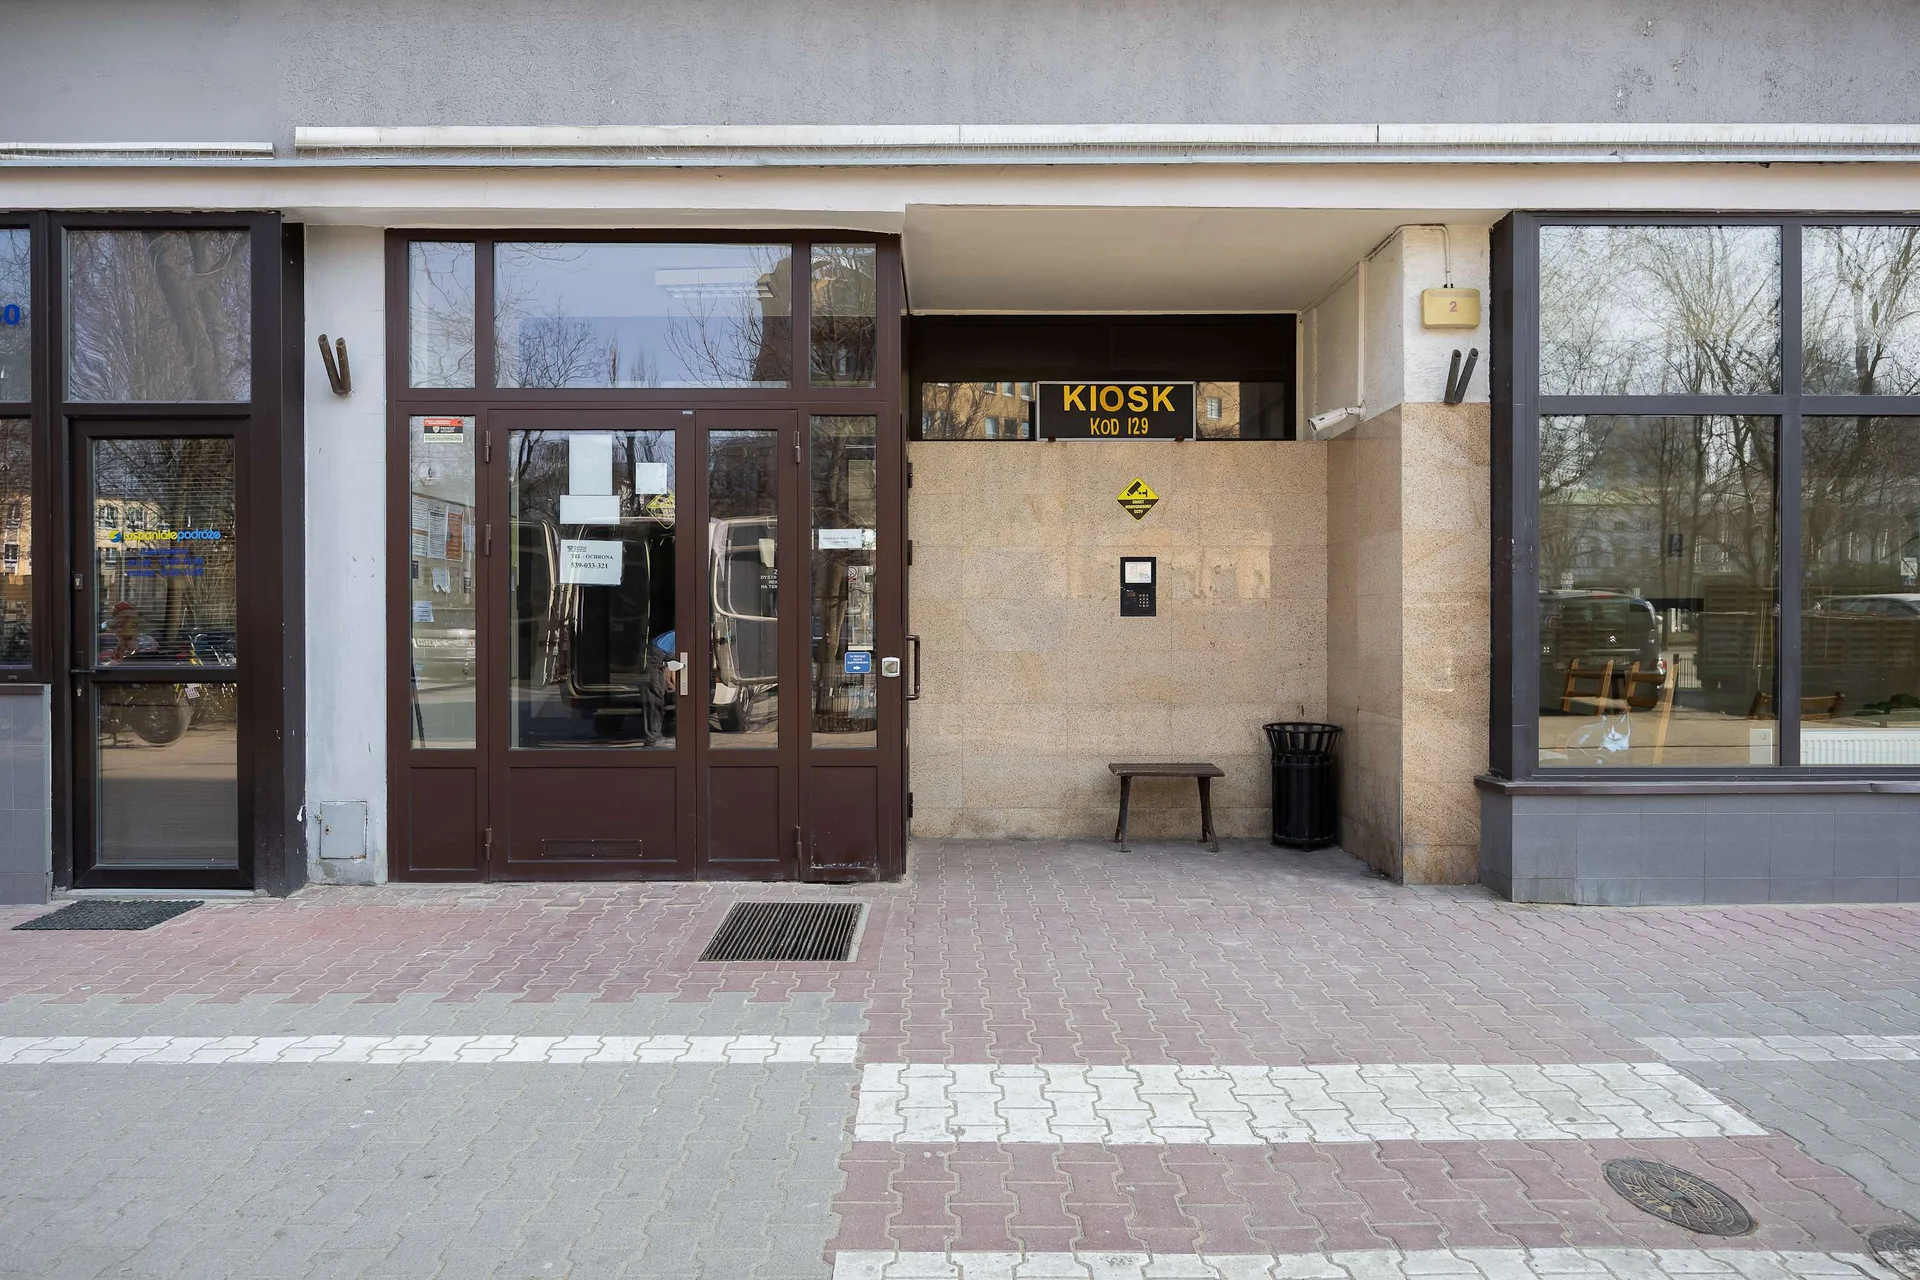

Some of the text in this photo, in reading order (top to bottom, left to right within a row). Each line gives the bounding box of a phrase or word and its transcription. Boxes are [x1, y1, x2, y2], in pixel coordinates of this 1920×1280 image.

[0, 304, 20, 326] 0
[1449, 301, 1458, 312] 2
[1063, 385, 1176, 412] KIOSK
[1090, 417, 1149, 435] KOD 129
